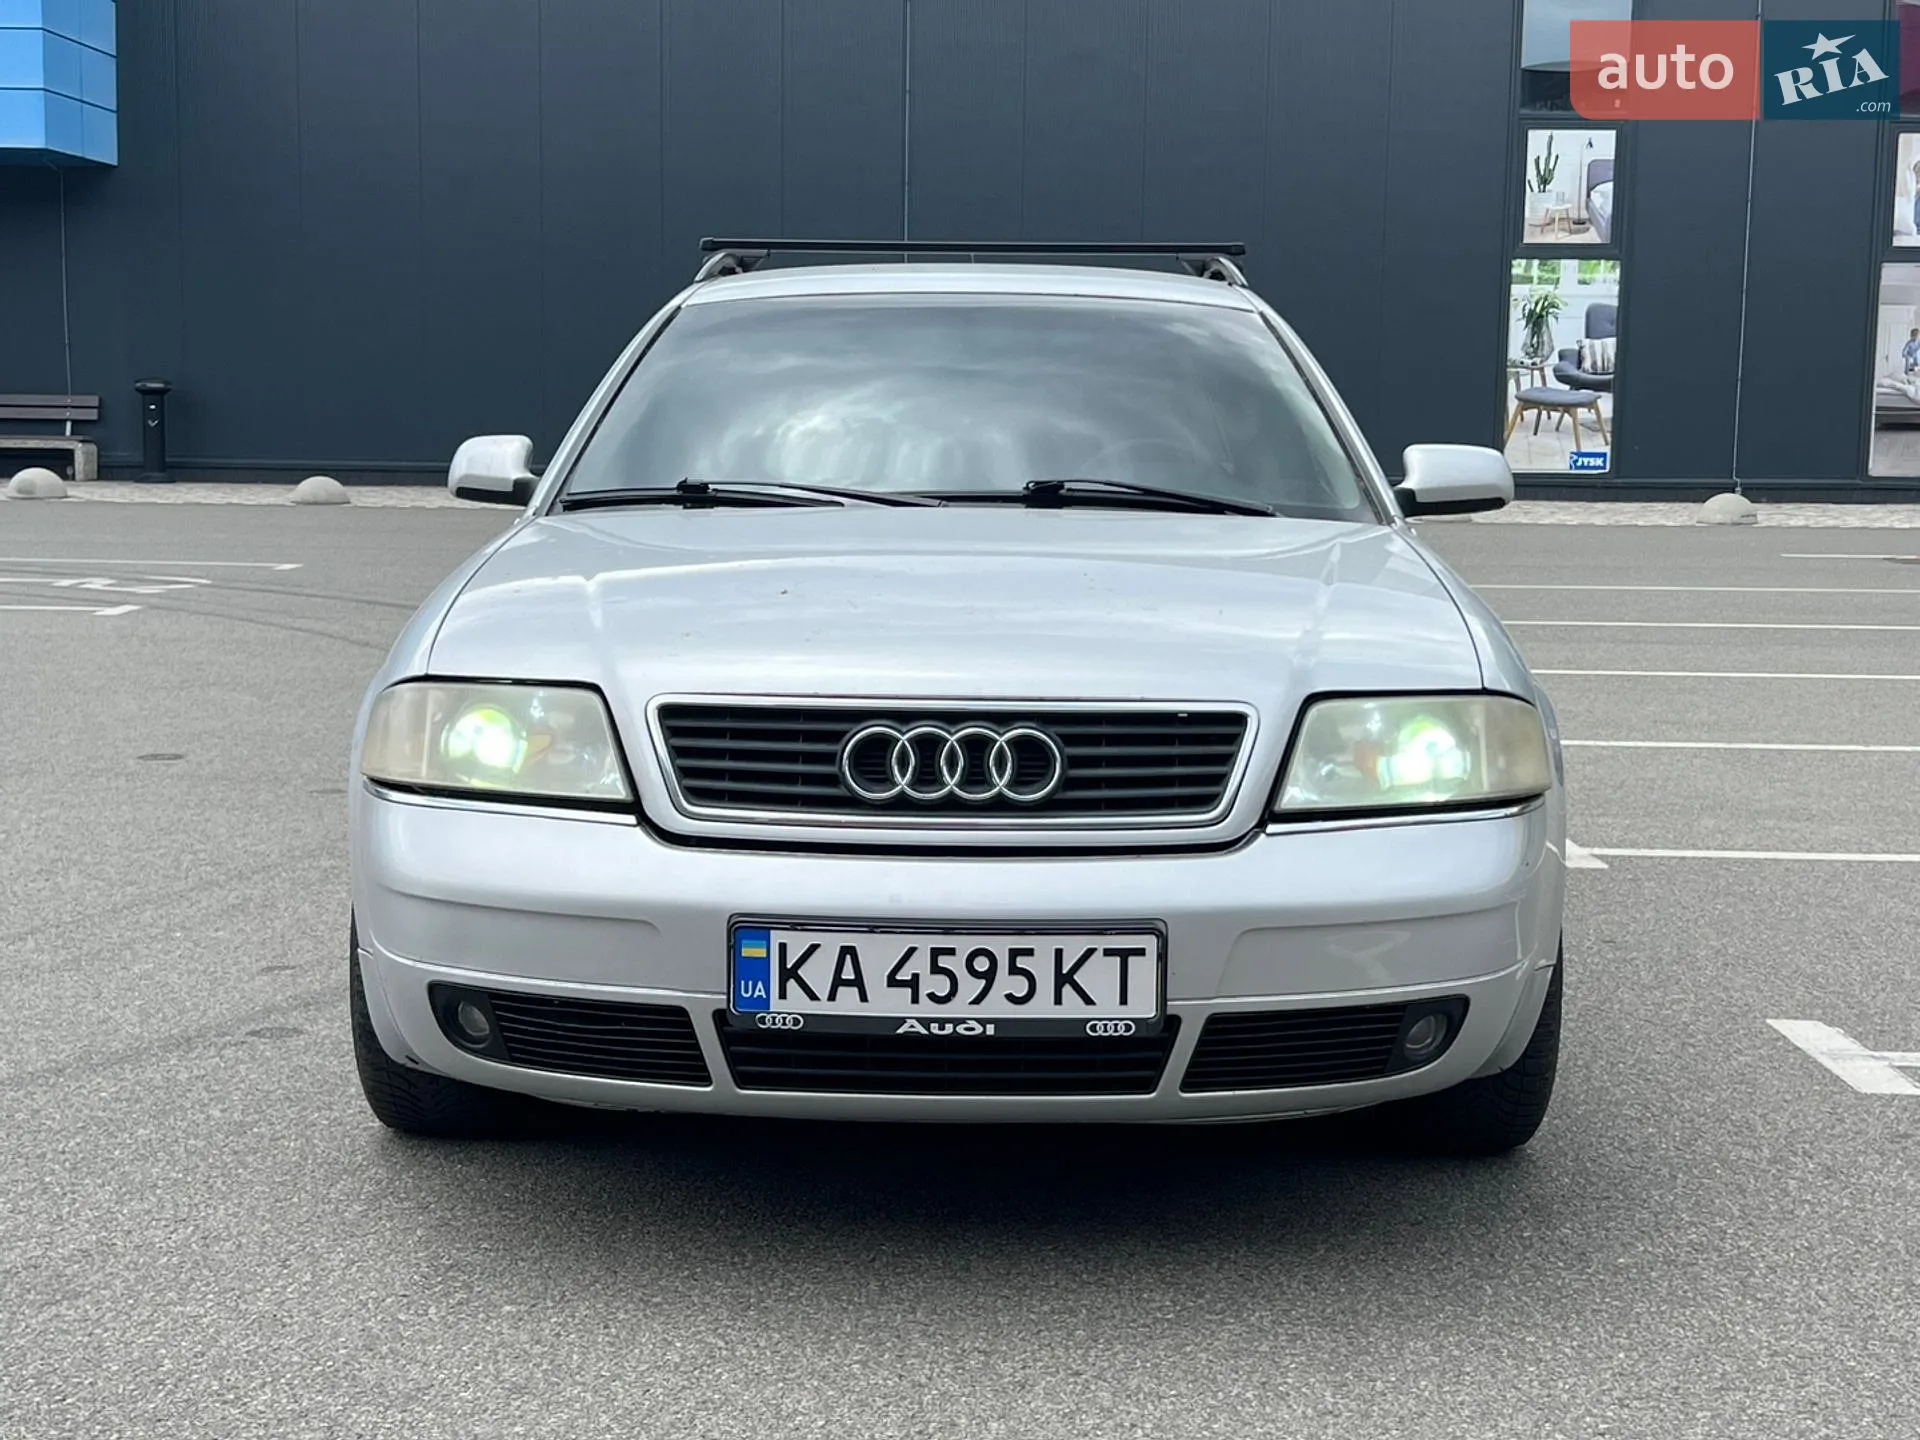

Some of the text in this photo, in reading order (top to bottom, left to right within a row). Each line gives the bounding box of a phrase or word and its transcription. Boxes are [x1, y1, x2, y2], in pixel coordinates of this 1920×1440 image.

[1576, 457, 1604, 466] JYSK
[777, 941, 1147, 1006] KA 4595 KT
[740, 980, 767, 999] UA
[895, 1019, 995, 1036] Audi
